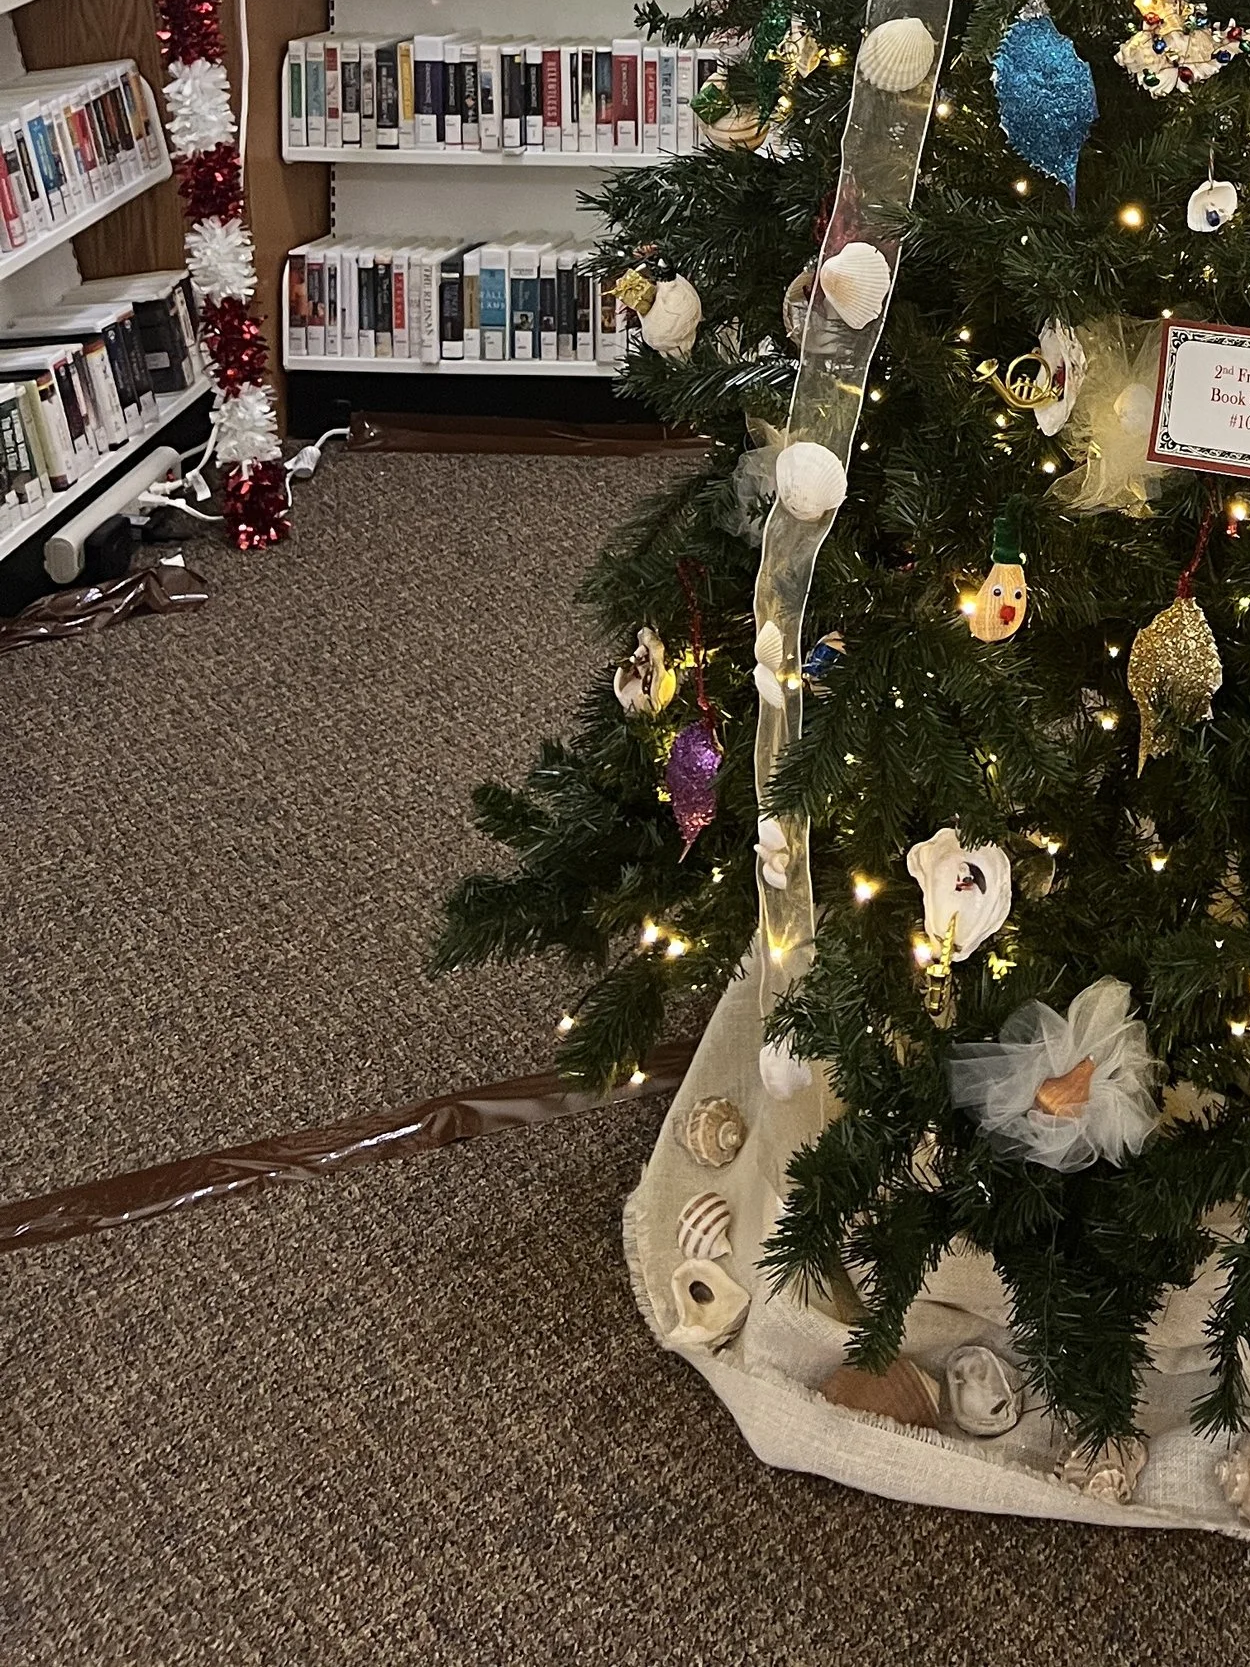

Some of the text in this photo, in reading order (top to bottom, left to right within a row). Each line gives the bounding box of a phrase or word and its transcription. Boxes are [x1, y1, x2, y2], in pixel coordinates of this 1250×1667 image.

[661, 74, 672, 108] THE PLOT
[1214, 365, 1234, 379] 2nd
[1210, 387, 1246, 406] Book
